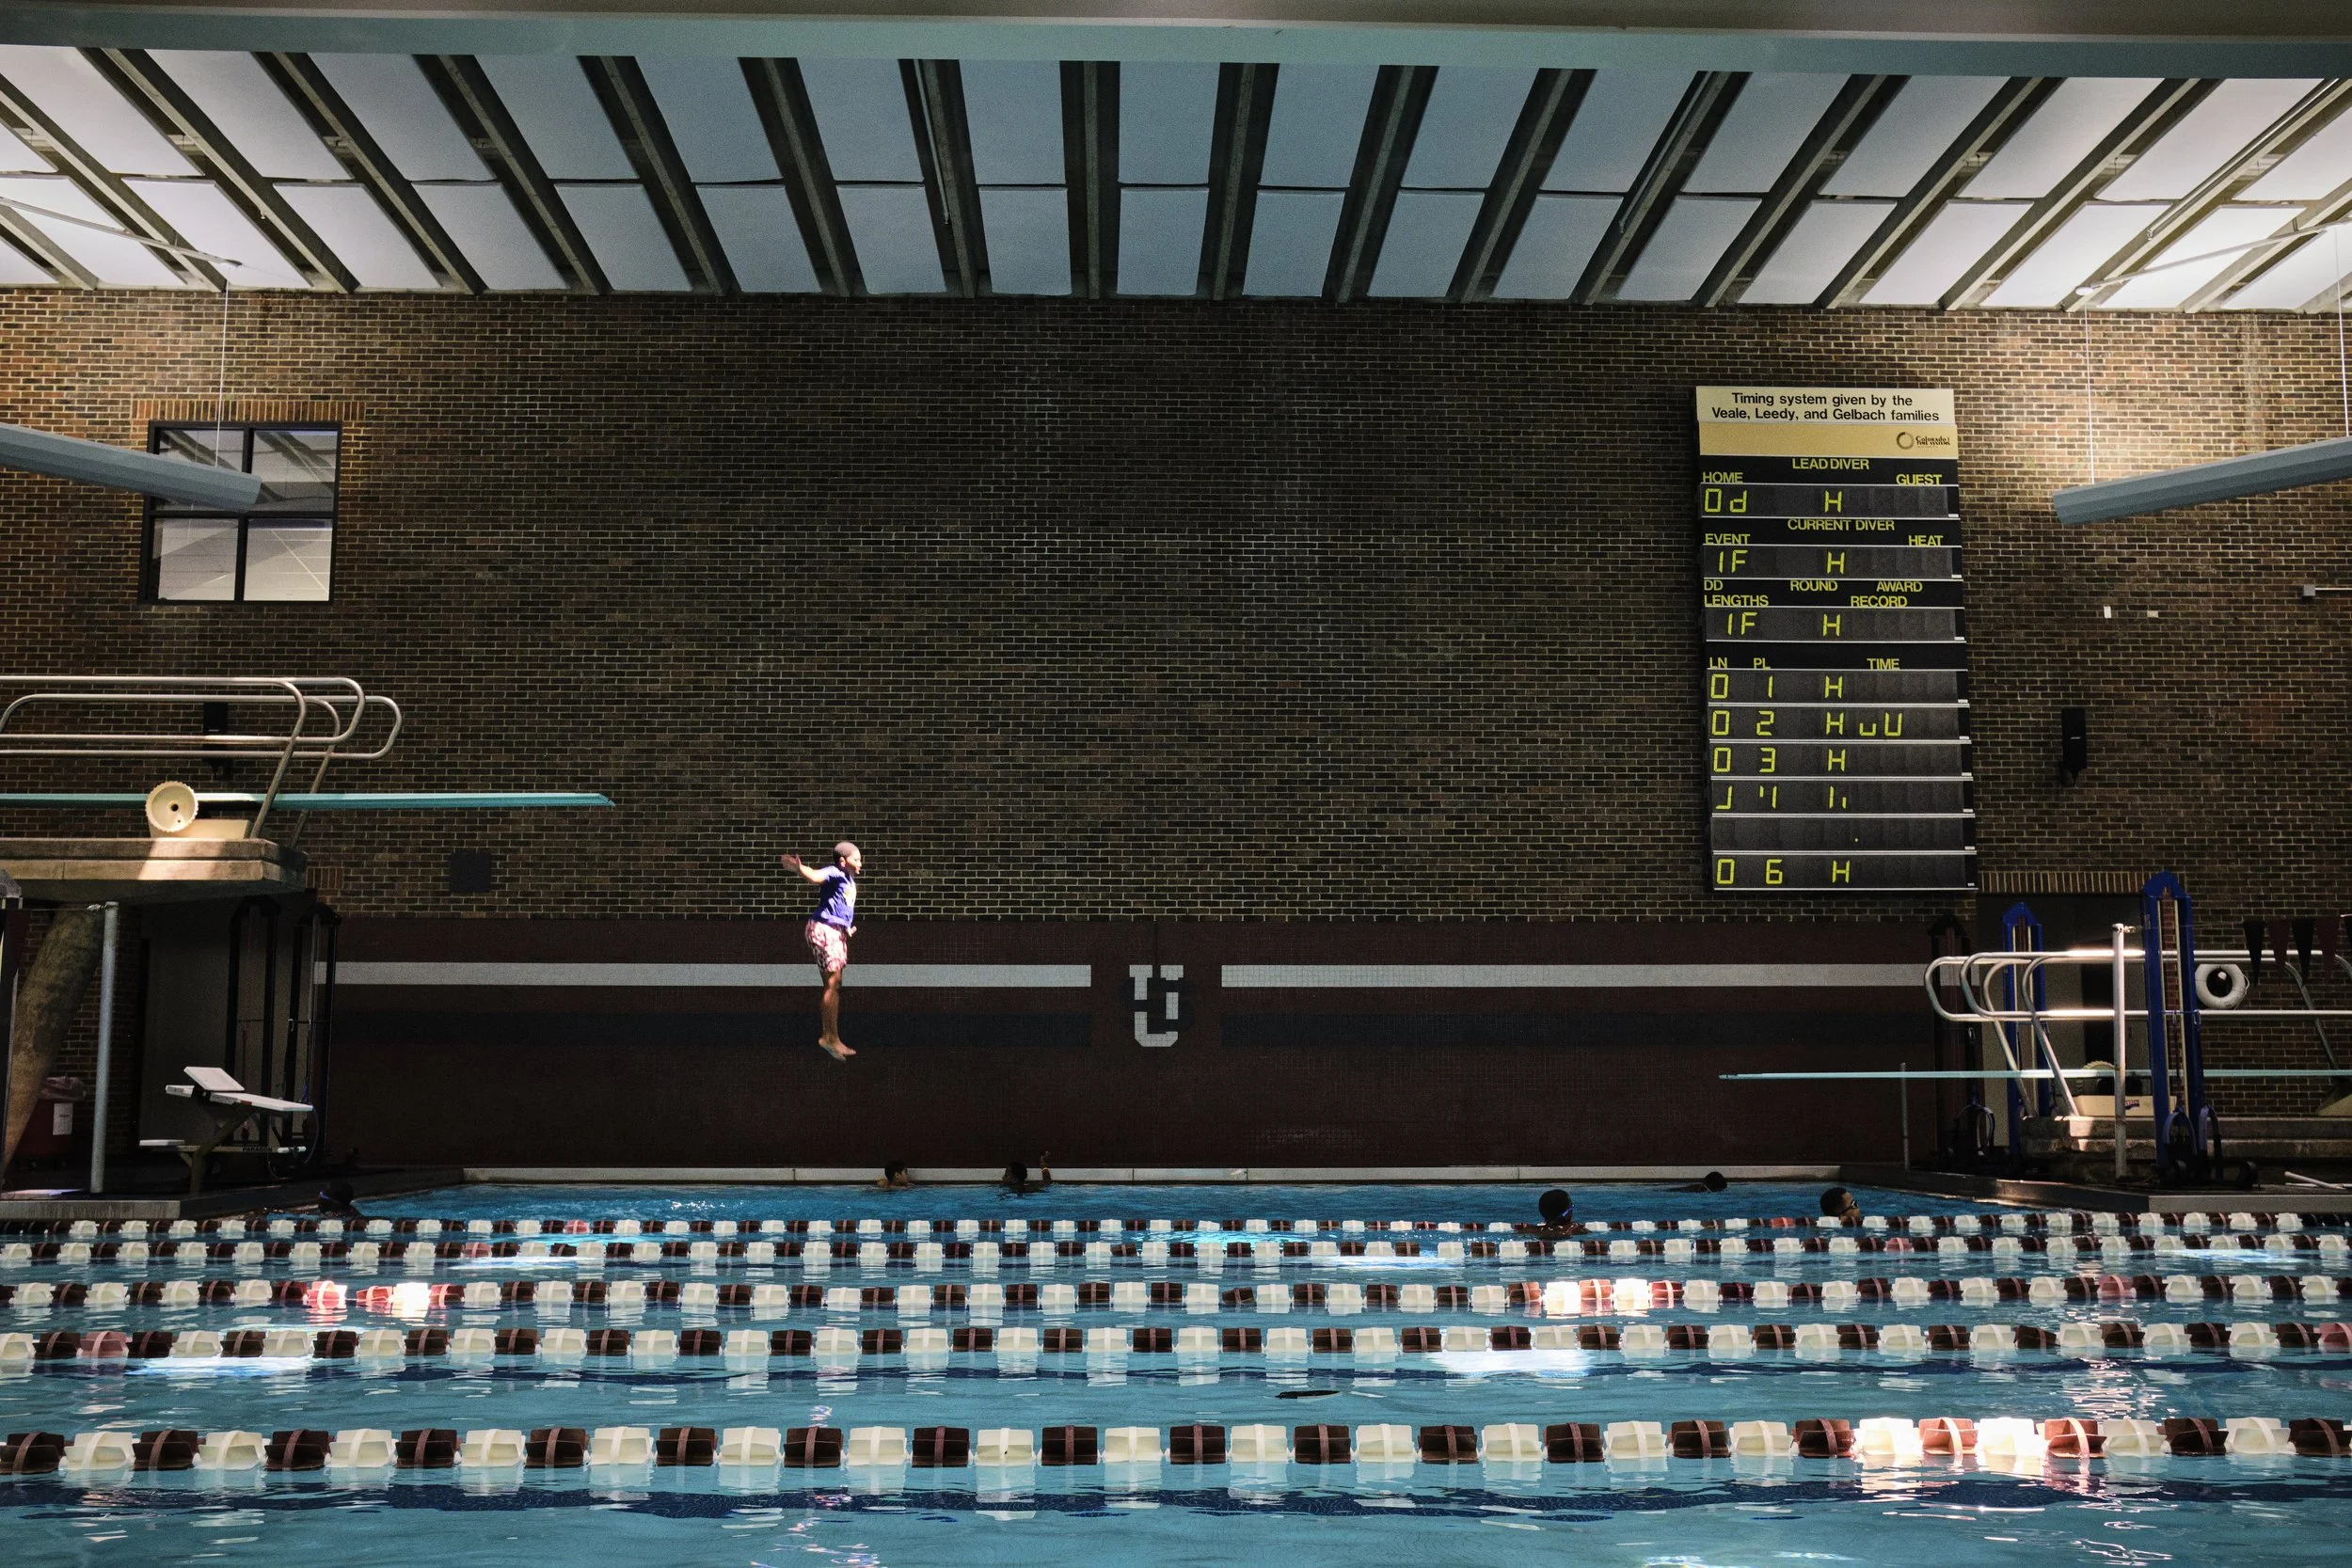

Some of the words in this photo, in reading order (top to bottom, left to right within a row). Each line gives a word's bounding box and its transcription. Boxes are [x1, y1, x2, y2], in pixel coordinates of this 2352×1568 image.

[1732, 392, 1774, 406] Timing
[1780, 394, 1827, 406] system
[1833, 394, 1867, 406] given
[1871, 394, 1886, 407] by
[1893, 395, 1913, 406] the
[1712, 407, 1750, 420] Veale,
[1756, 408, 1799, 420] Leedy,
[1804, 407, 1828, 420] and
[1833, 407, 1885, 420] Gelbach
[1891, 409, 1939, 421] families
[1792, 458, 1828, 469] LEAD
[1830, 457, 1869, 469] DIVER
[1703, 472, 1742, 483] HOME
[1896, 474, 1942, 485] GUEST
[1788, 518, 1851, 531] CURRENT
[1856, 519, 1895, 531] DIVER
[1706, 533, 1750, 545] EVENT
[1909, 535, 1942, 546] HEAT
[1704, 578, 1723, 591] DD
[1790, 579, 1837, 591] ROUND
[1877, 579, 1923, 592] AWARD
[1705, 594, 1769, 607] LENGTHS
[1851, 595, 1907, 609] RECORD
[1709, 657, 1727, 669] LN
[1754, 657, 1771, 670] PL
[1867, 658, 1899, 670] TIME
[1756, 710, 1774, 736] 2
[1759, 747, 1776, 772] 3
[1766, 859, 1783, 884] 6
